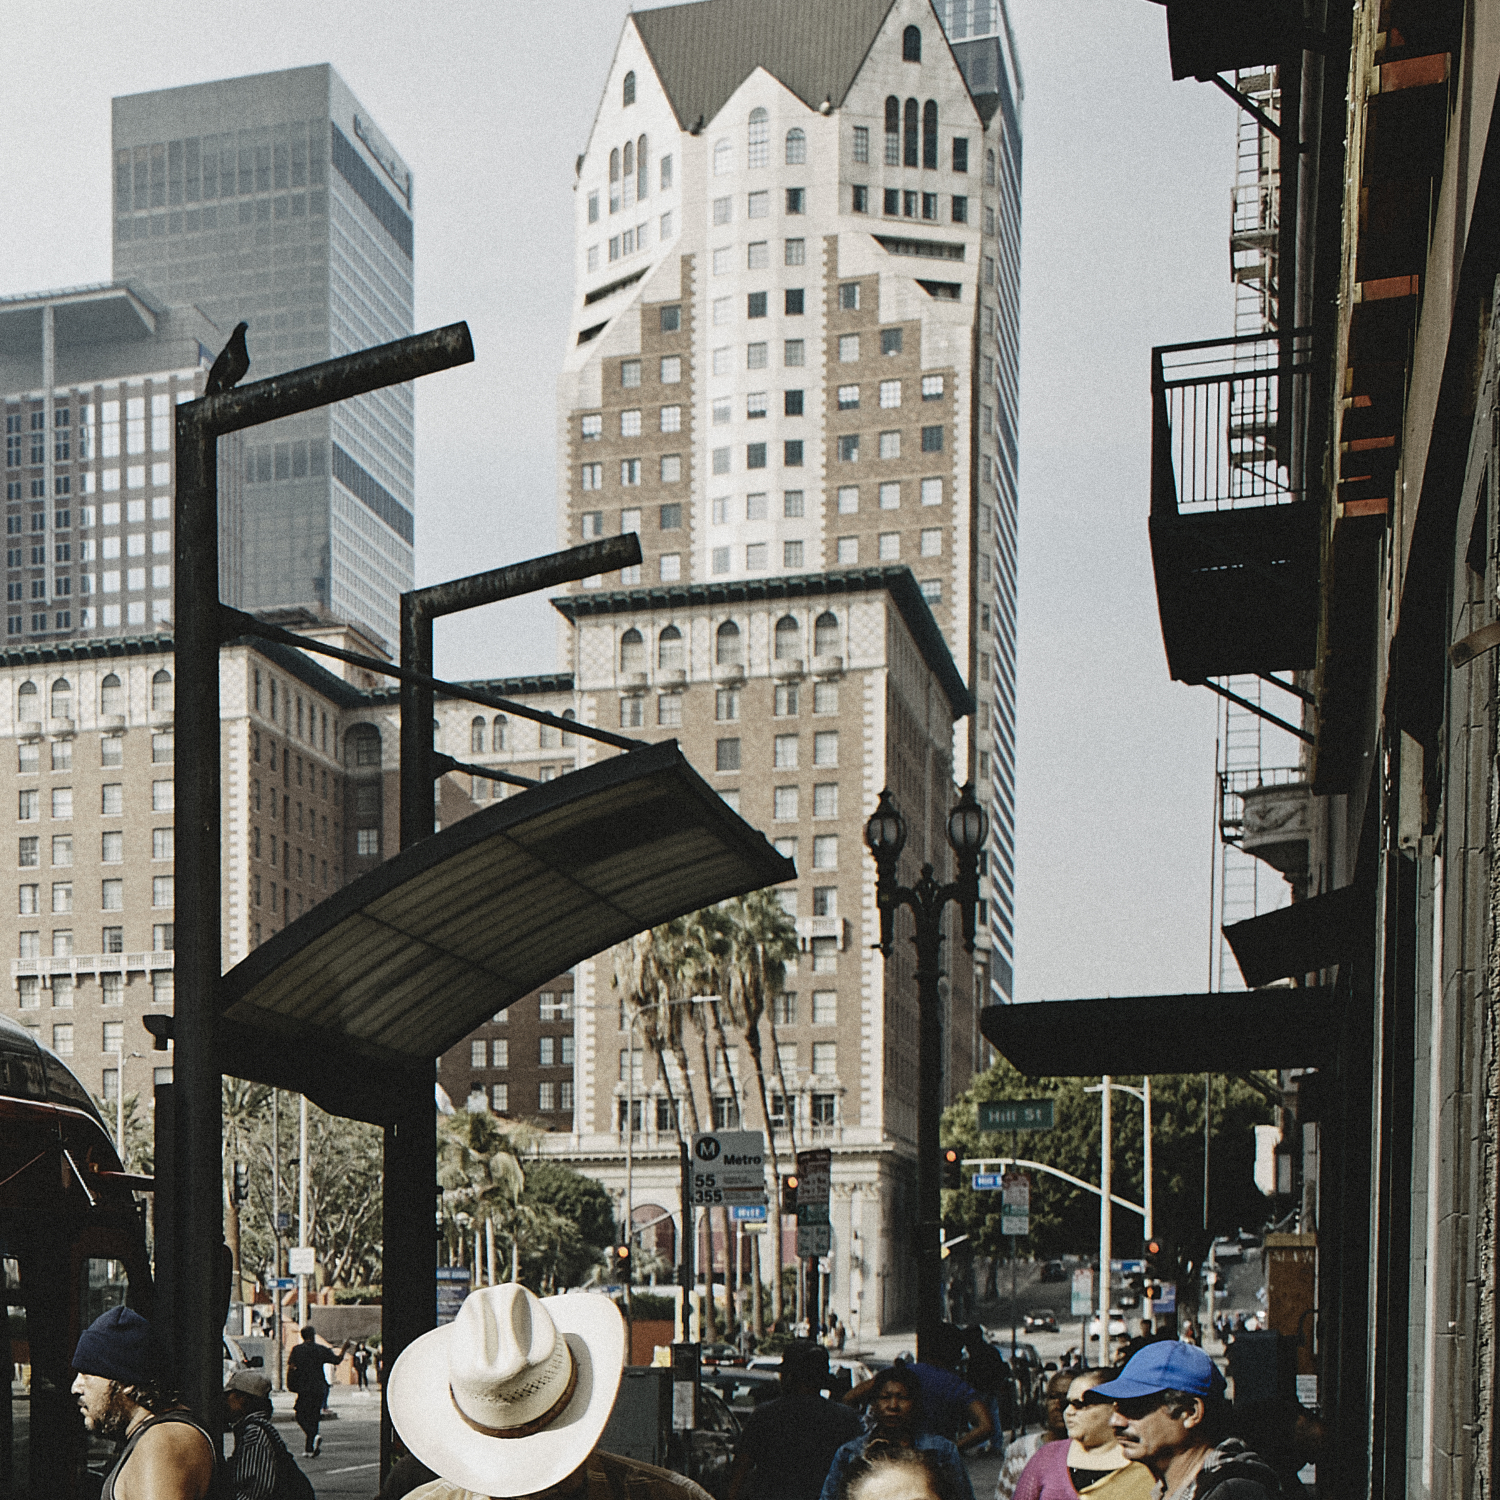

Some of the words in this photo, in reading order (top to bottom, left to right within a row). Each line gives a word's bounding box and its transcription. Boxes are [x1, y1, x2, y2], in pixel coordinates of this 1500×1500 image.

[988, 1109, 1017, 1122] Hill
[1024, 1108, 1042, 1121] St
[723, 1154, 762, 1166] Metro
[694, 1173, 716, 1188] 55
[694, 1189, 723, 1203] 355
